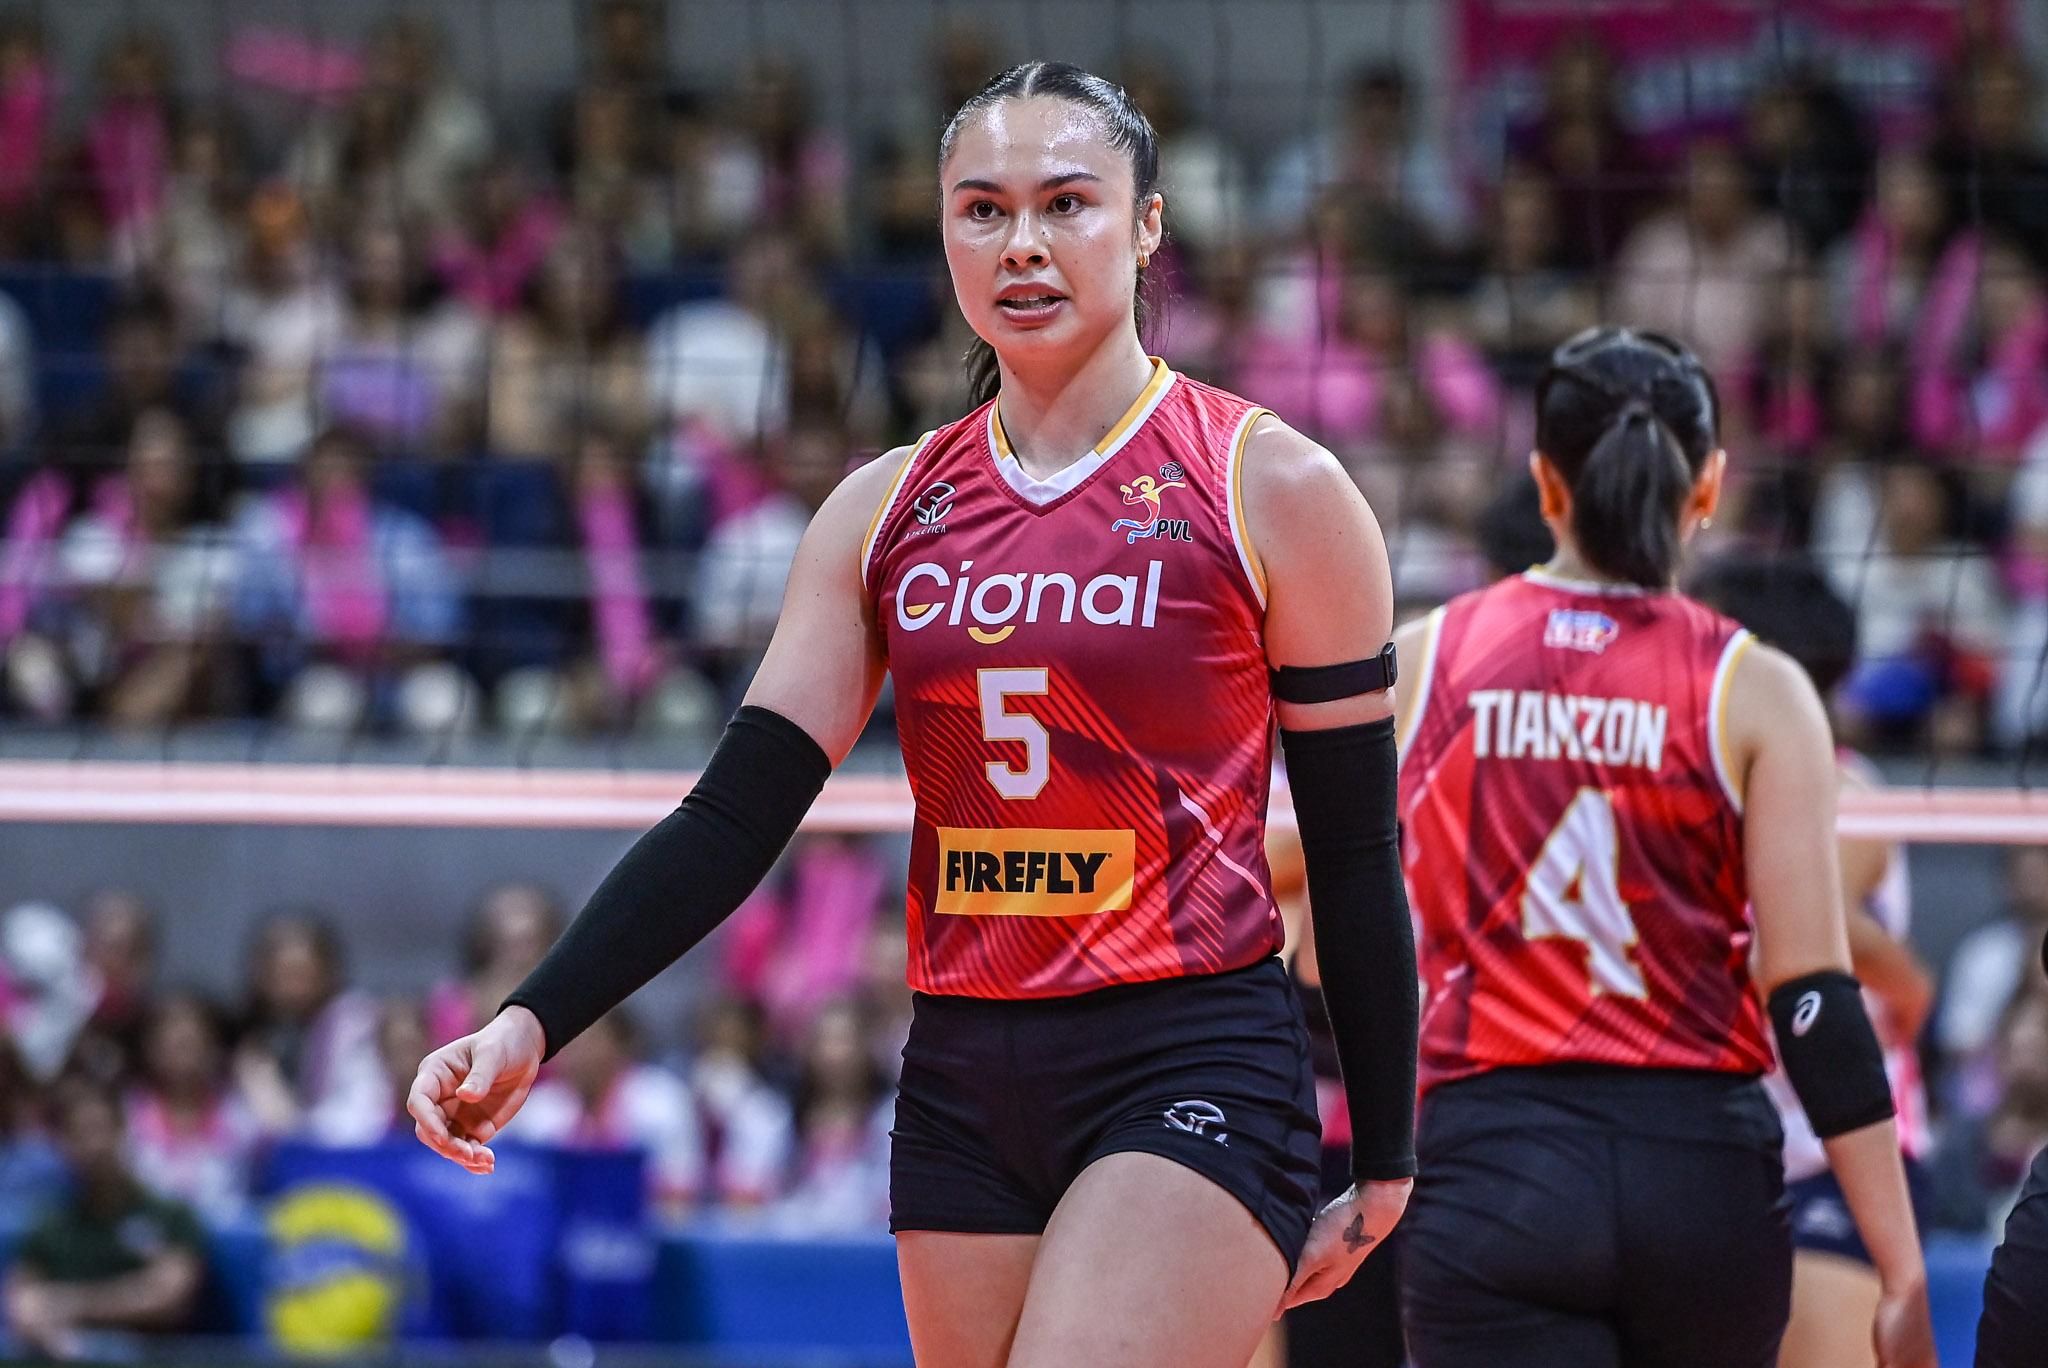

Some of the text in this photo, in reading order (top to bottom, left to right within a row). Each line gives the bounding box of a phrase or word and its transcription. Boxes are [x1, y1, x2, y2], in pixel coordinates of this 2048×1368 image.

[1155, 519, 1193, 542] PVL
[896, 560, 1162, 644] Cignal
[977, 667, 1049, 800] 5
[1468, 688, 1668, 772] TIANZON
[946, 850, 1108, 894] FIREFLY
[1520, 785, 1648, 1001] 4
